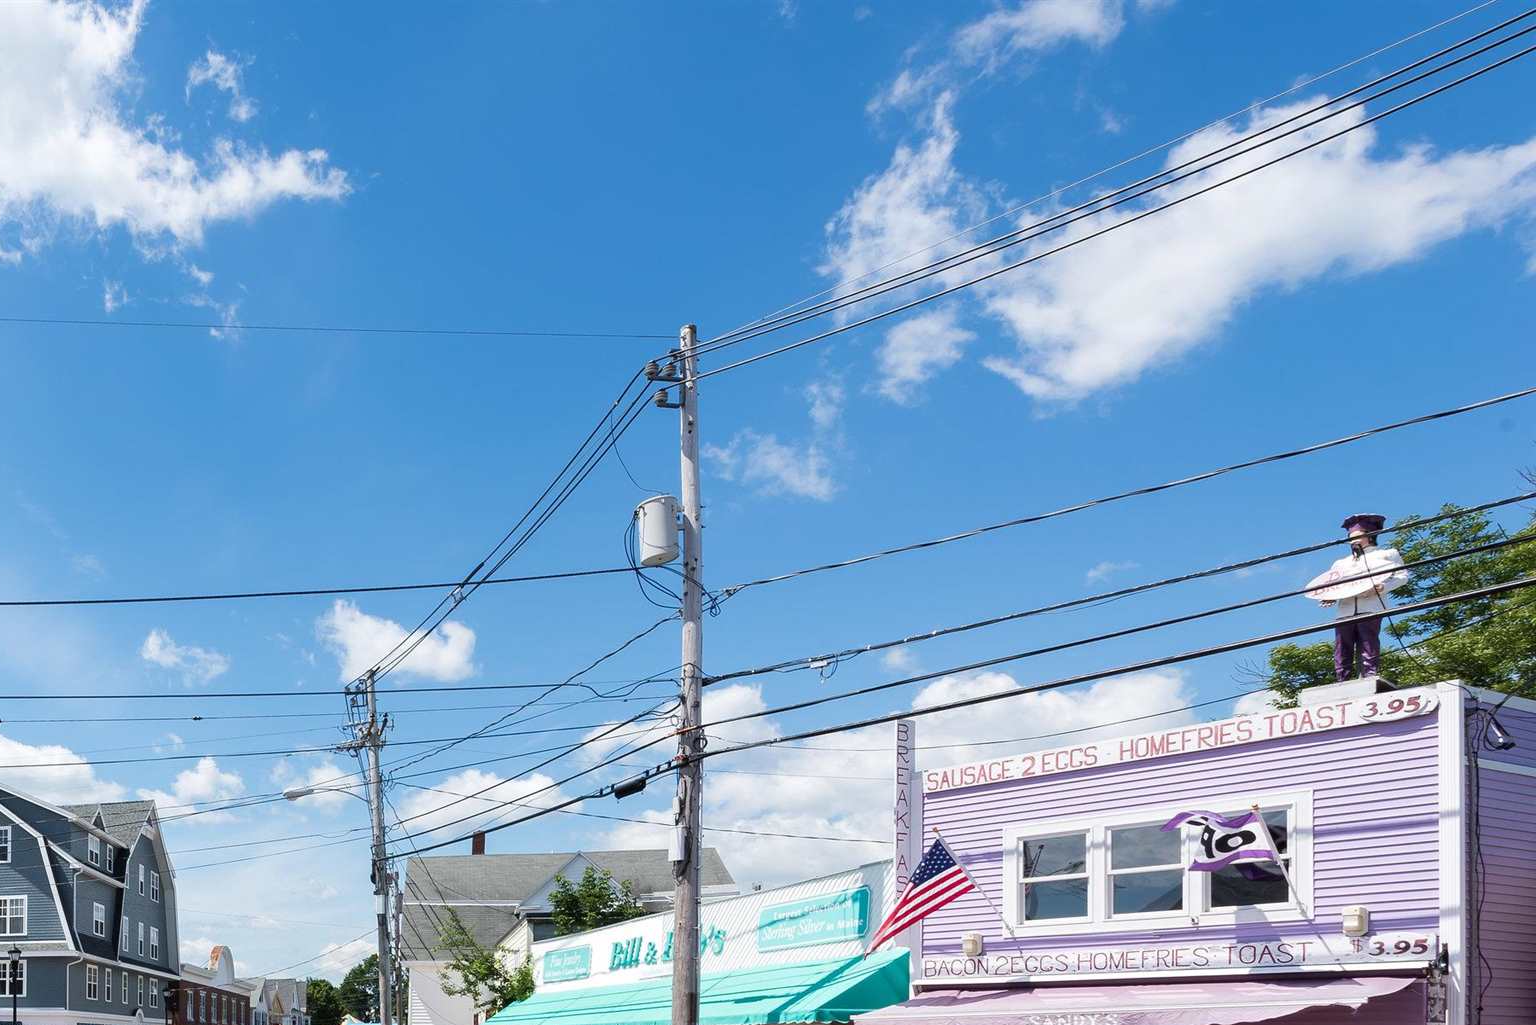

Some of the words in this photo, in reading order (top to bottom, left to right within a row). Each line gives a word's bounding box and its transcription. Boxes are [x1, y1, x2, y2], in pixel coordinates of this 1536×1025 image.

[927, 760, 1013, 791] SAUSAGE
[1022, 756, 1037, 777] 2
[1042, 746, 1097, 773] EGGS
[1119, 720, 1253, 761] HOMEFRIES
[1264, 702, 1353, 738] TOAST
[1363, 695, 1421, 719] 3.95
[896, 723, 910, 899] BREAKFAS
[610, 936, 643, 970] Bill
[644, 941, 658, 965] &
[924, 958, 989, 977] BACON
[1077, 948, 1209, 971] HOMEFRIES
[1222, 942, 1313, 965] TOAST
[1369, 938, 1429, 956] 3.95
